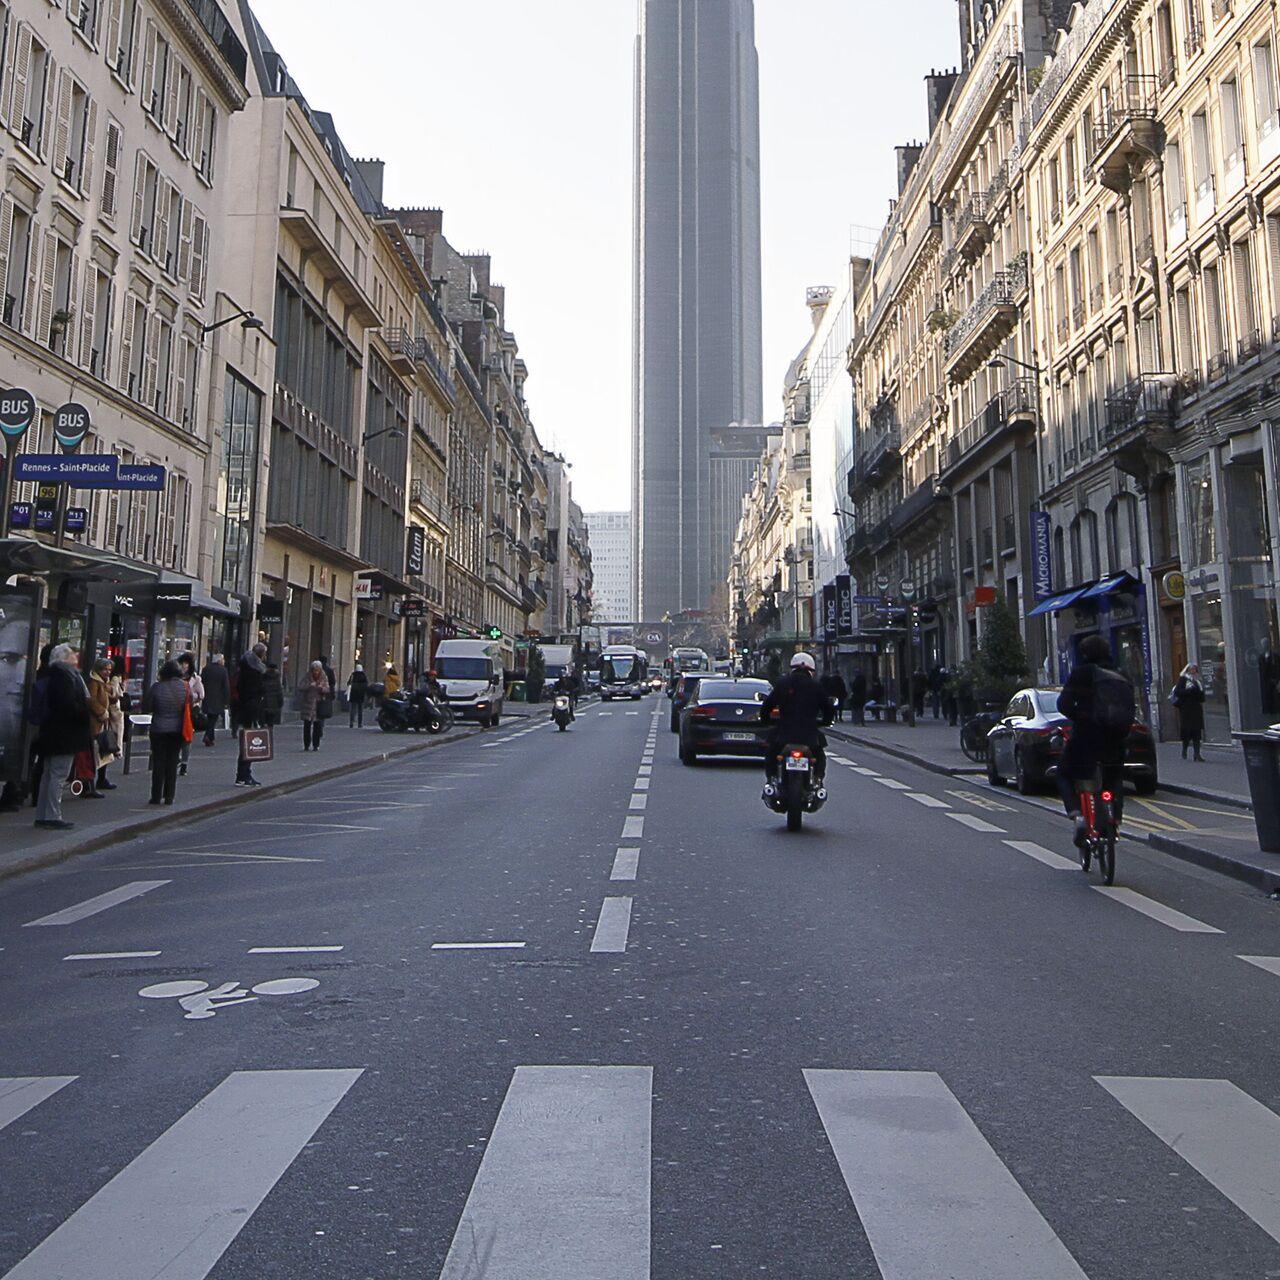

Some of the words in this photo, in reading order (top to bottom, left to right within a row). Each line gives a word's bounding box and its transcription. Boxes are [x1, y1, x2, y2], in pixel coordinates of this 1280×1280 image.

[1, 400, 28, 414] BUS
[58, 414, 84, 427] BUS
[22, 463, 51, 472] Rennes
[59, 463, 110, 472] Saint-Placide
[119, 472, 158, 482] int-Placide
[41, 487, 54, 498] 96
[409, 532, 422, 571] Etam
[840, 590, 850, 627] fnac
[826, 600, 835, 632] fnac
